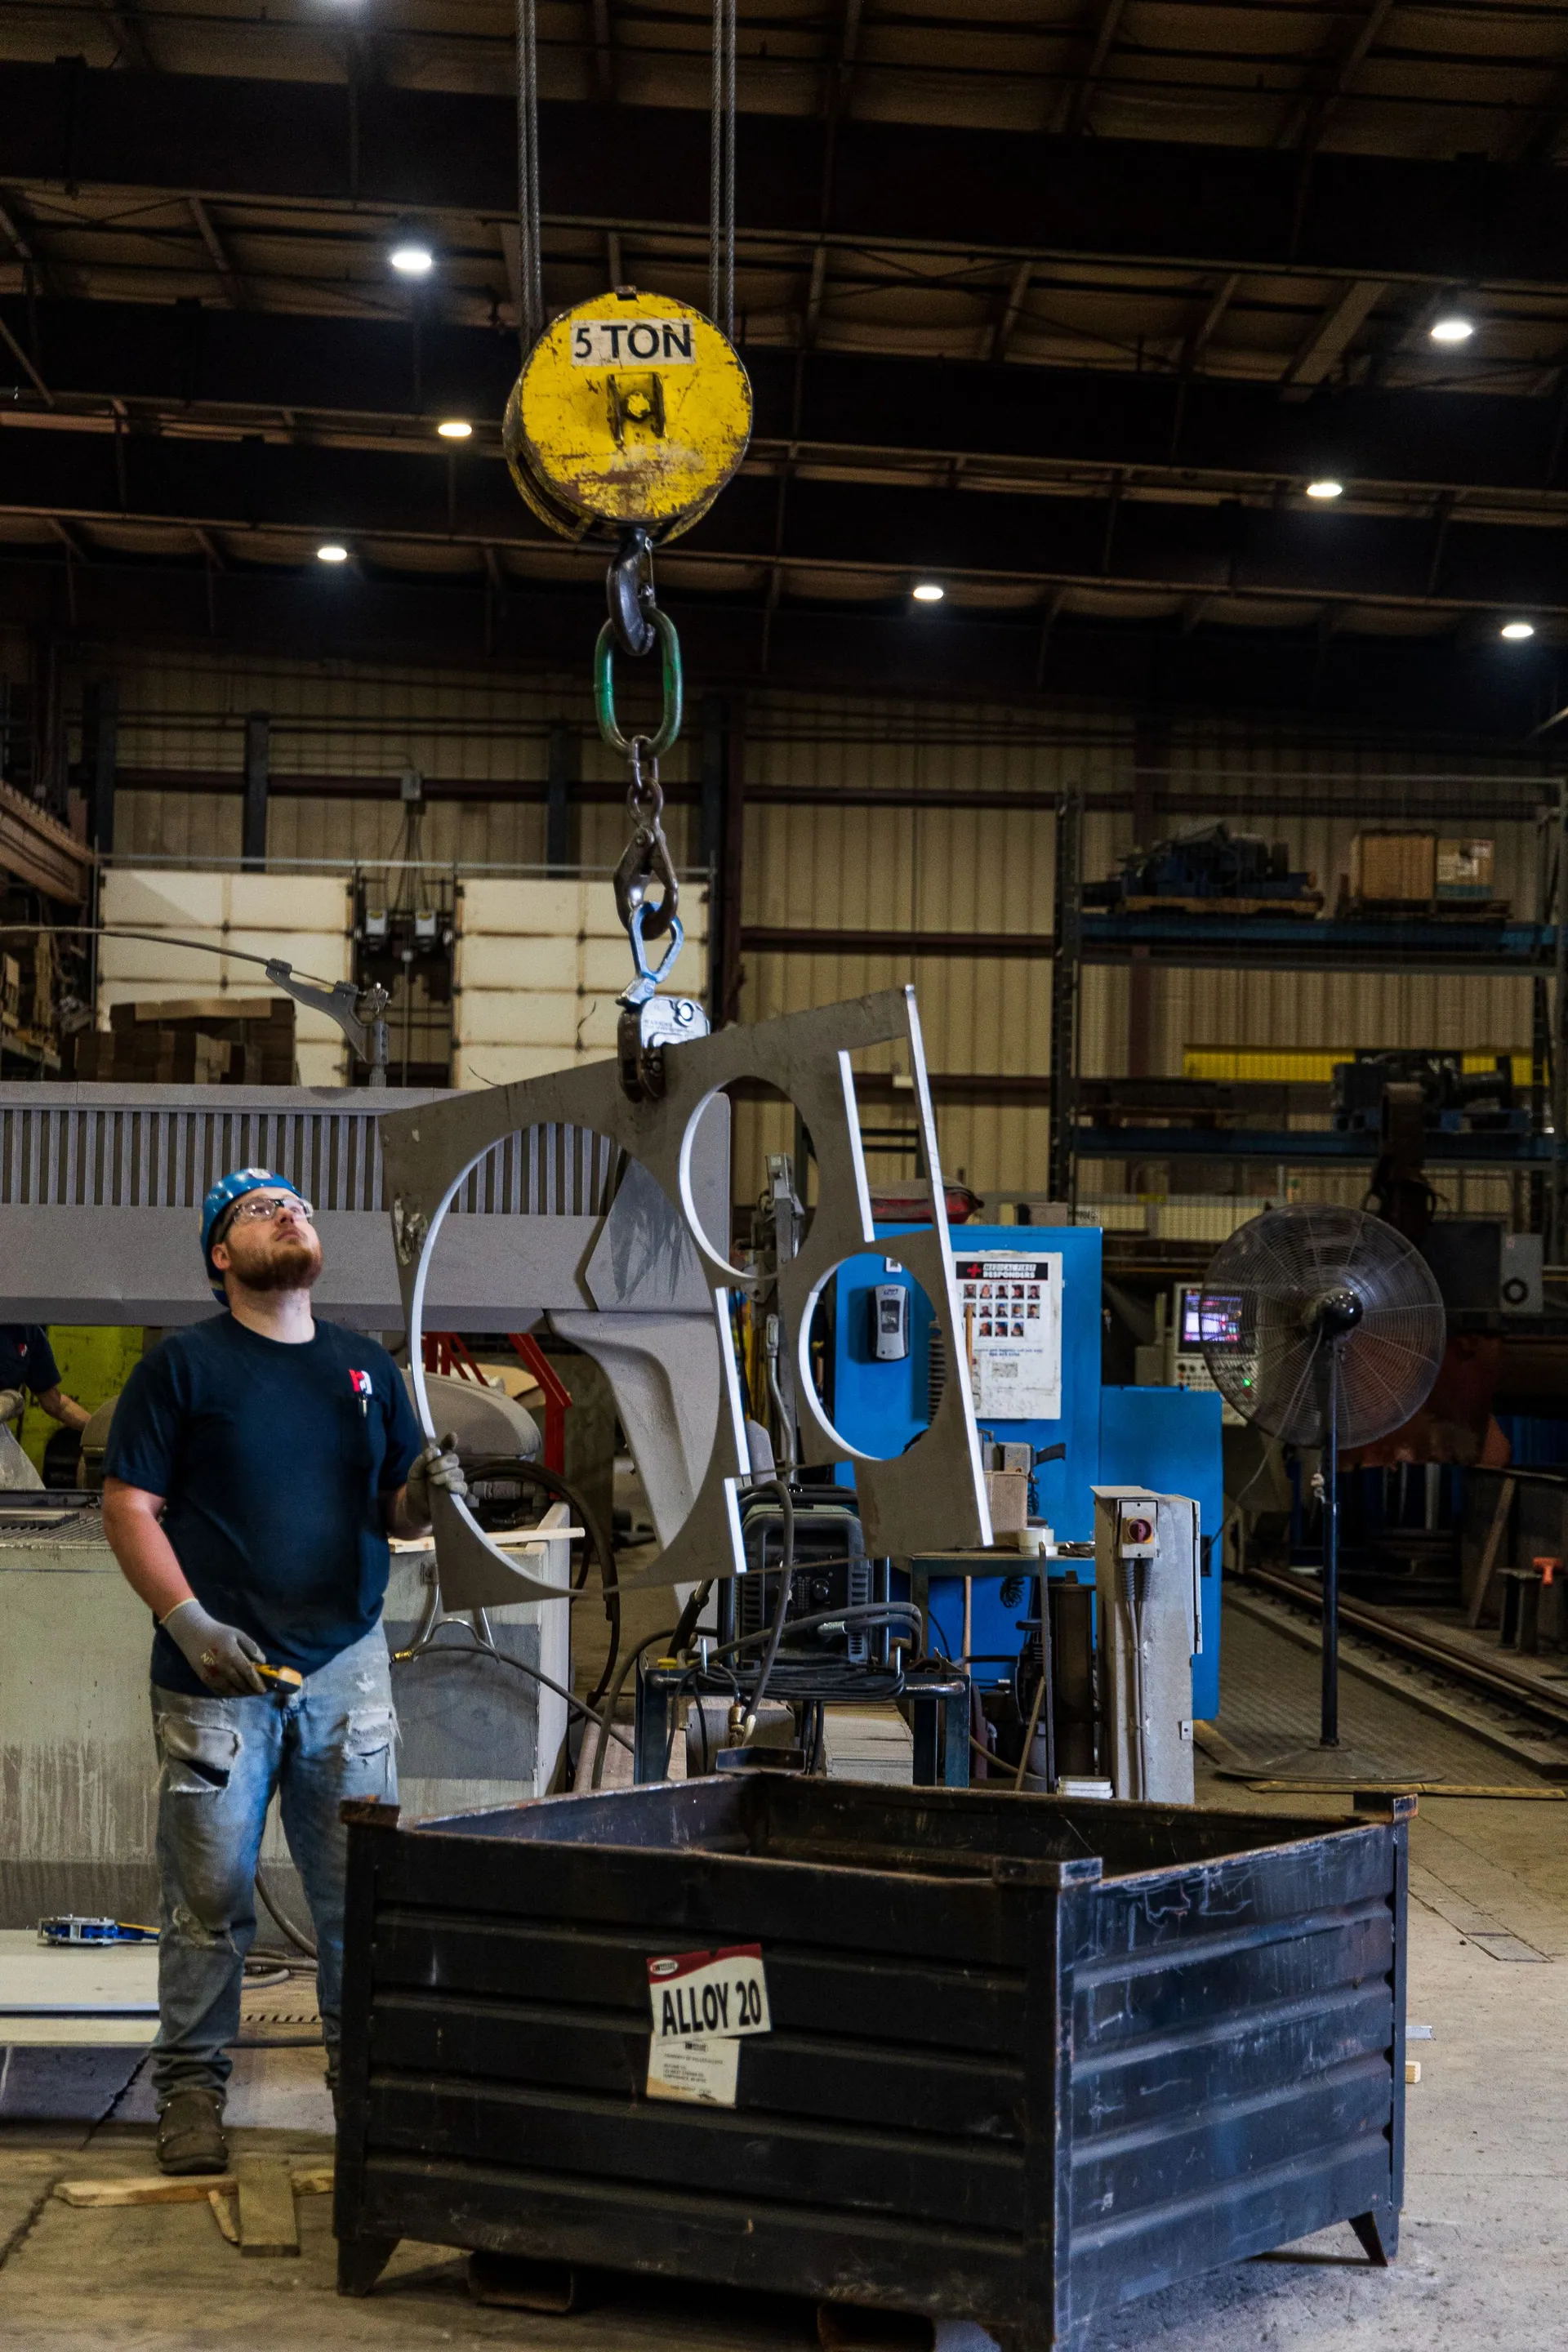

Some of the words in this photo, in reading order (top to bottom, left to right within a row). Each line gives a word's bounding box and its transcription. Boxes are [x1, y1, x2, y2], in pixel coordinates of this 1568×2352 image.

[574, 327, 592, 359] 5
[601, 323, 693, 359] TON
[662, 1981, 728, 2037] ALLOY
[735, 1978, 762, 2027] 20
